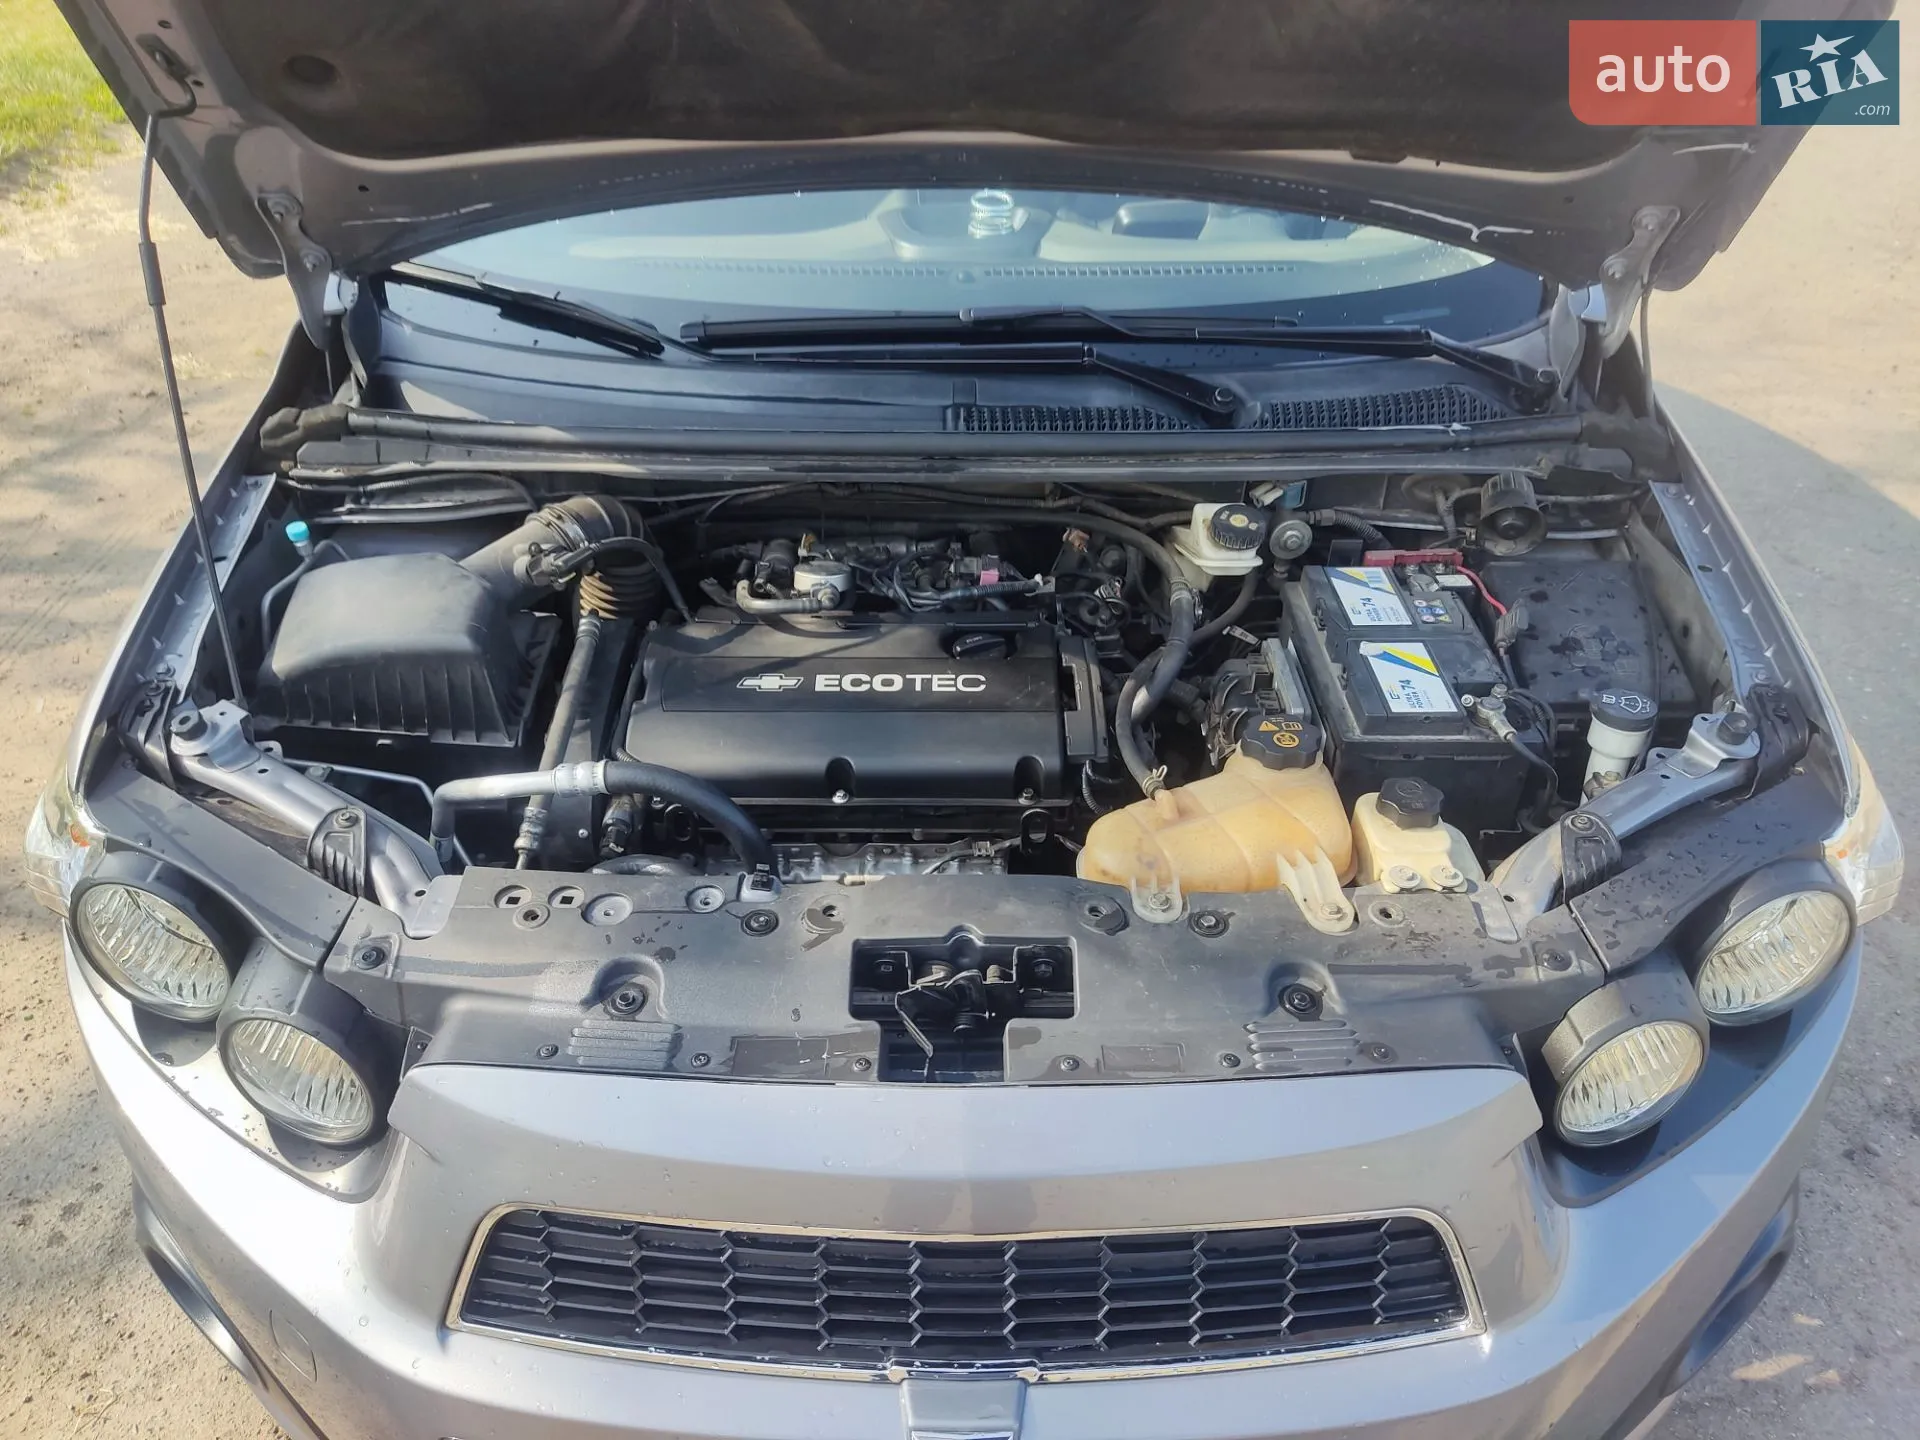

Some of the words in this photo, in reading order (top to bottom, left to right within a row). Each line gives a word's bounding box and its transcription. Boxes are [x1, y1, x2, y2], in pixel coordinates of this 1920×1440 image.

[1360, 597, 1376, 607] 74
[814, 673, 987, 692] ECOTEC
[1398, 679, 1416, 691] 74
[1404, 692, 1417, 709] ULTRA
[1411, 691, 1424, 709] POWER
